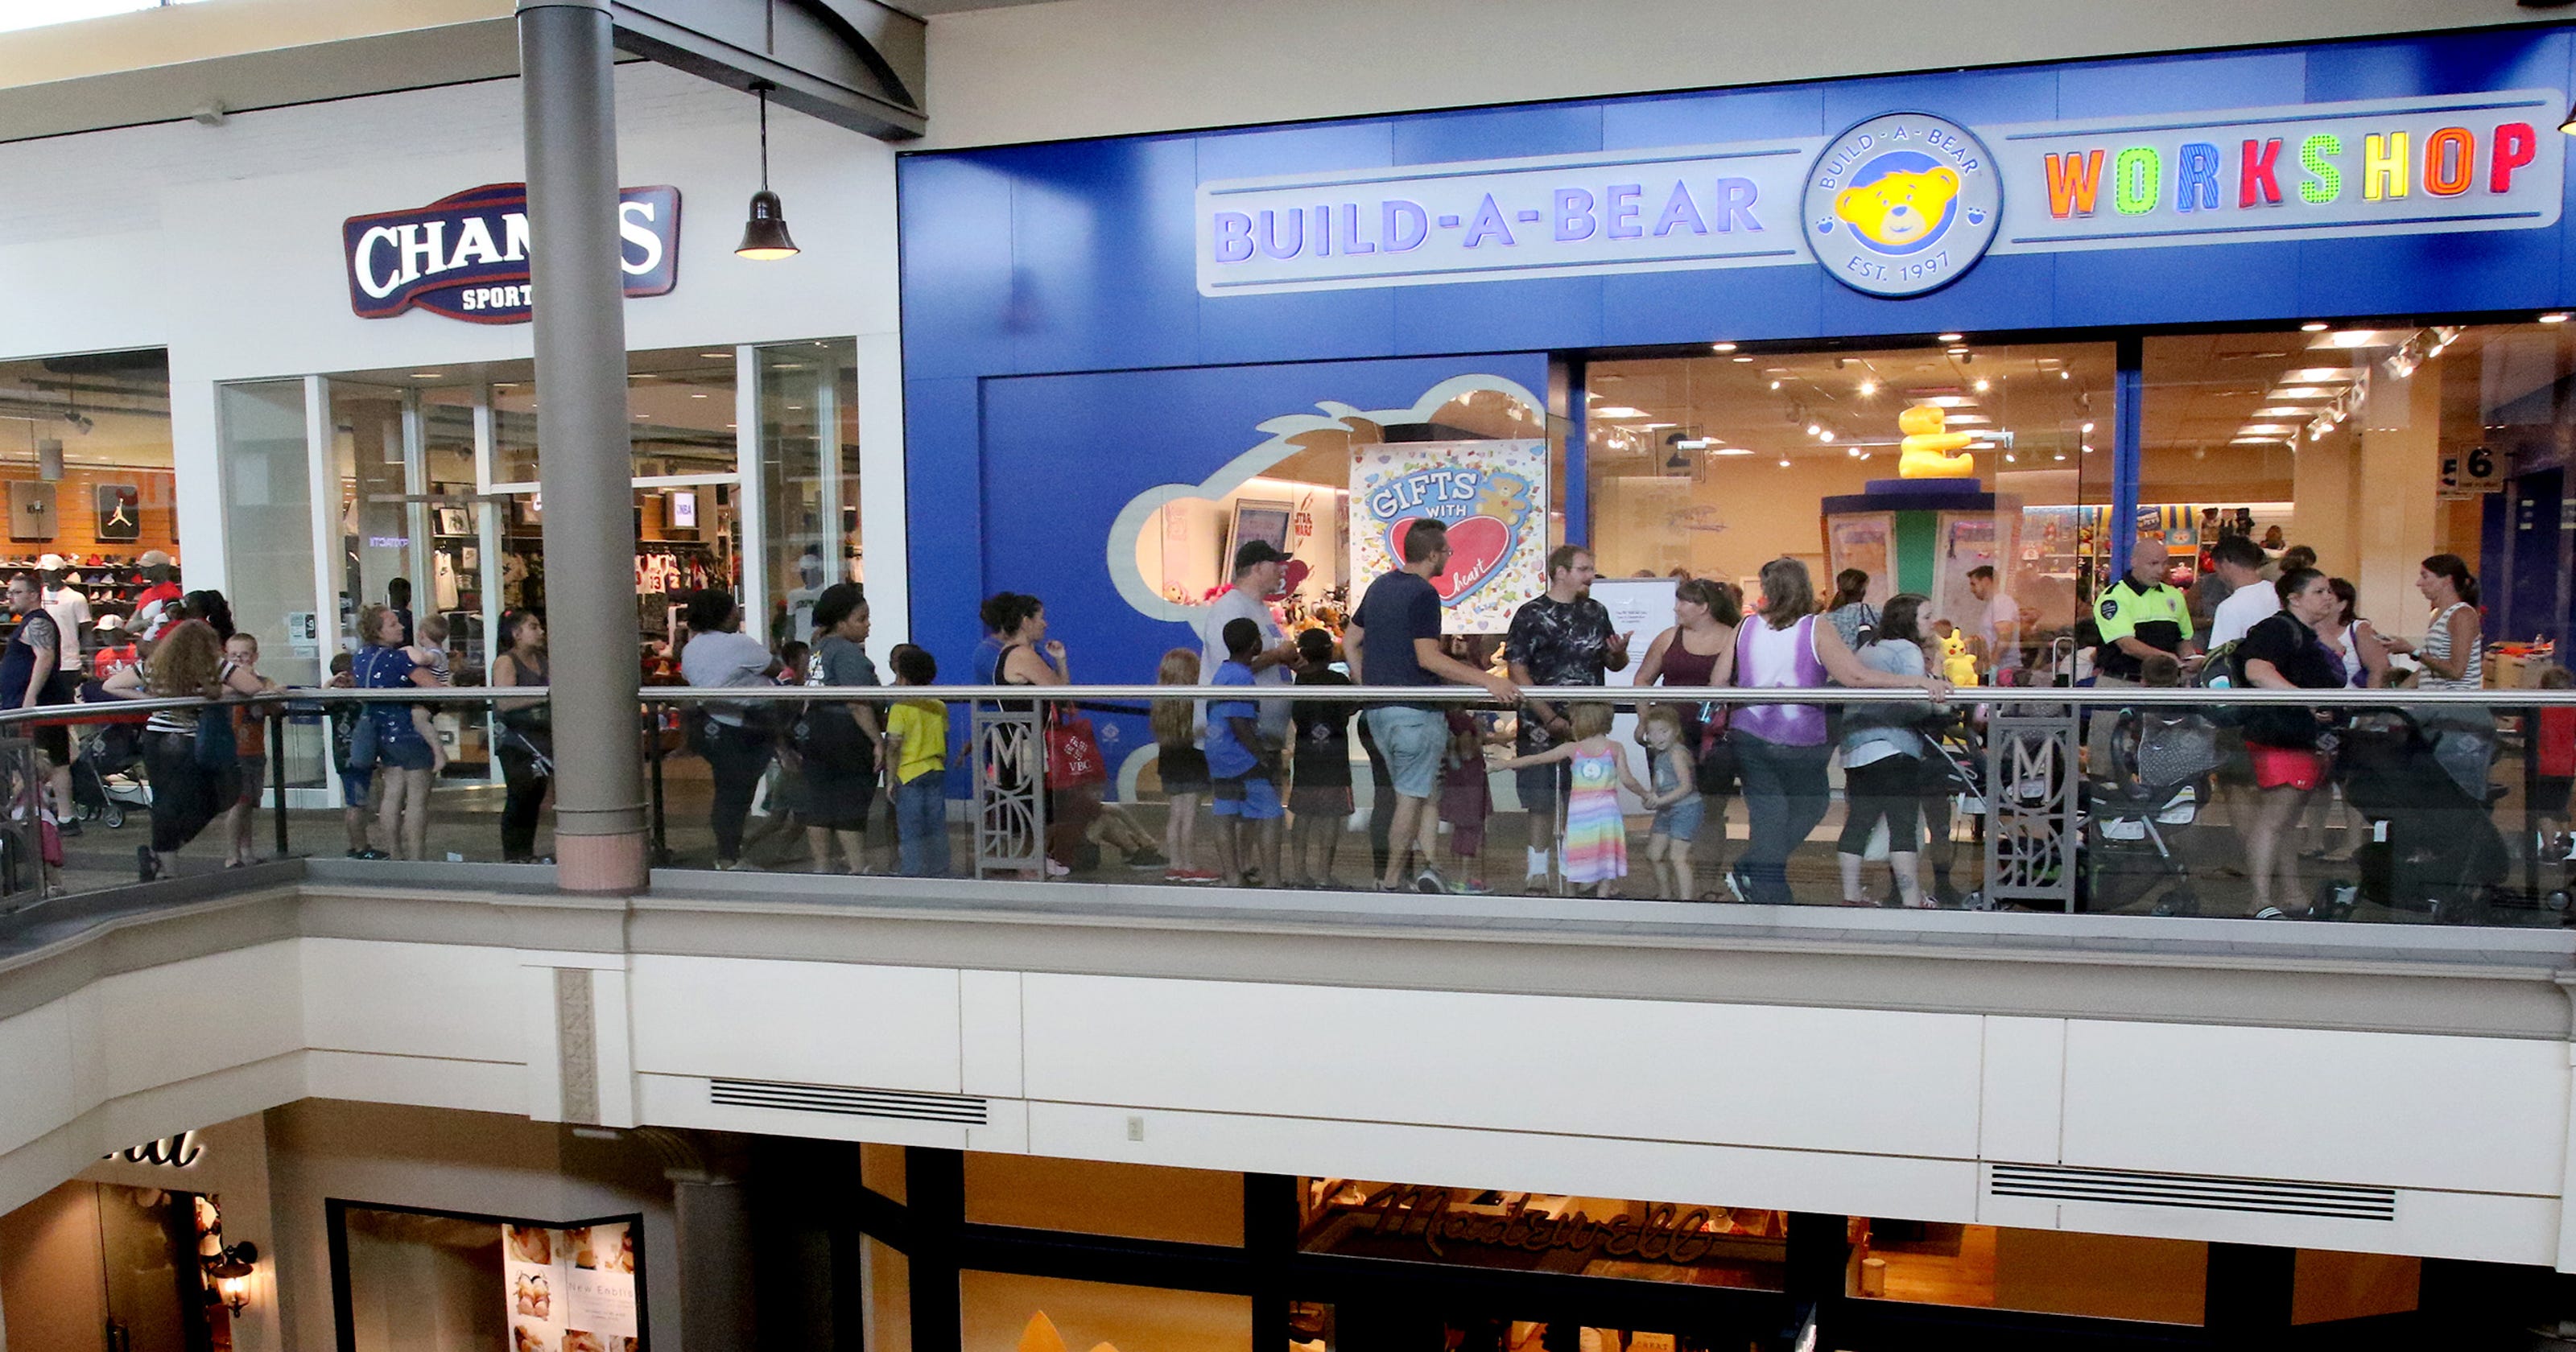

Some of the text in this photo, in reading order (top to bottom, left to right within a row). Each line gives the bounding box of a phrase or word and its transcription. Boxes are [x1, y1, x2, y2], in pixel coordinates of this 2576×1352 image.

[1819, 126, 1979, 190] BUILD-A-BEAR
[1215, 122, 2537, 262] BUILD-A-BEAR WORKSHOP
[1847, 250, 1951, 282] EST. 1997
[2468, 447, 2493, 478] 6
[1373, 472, 1479, 518] GIFTS
[1294, 512, 1312, 523] STAR
[1425, 505, 1468, 519] WITH
[1294, 525, 1313, 536] WARS
[1452, 559, 1488, 594] heart
[1366, 1184, 1712, 1263] Madewell
